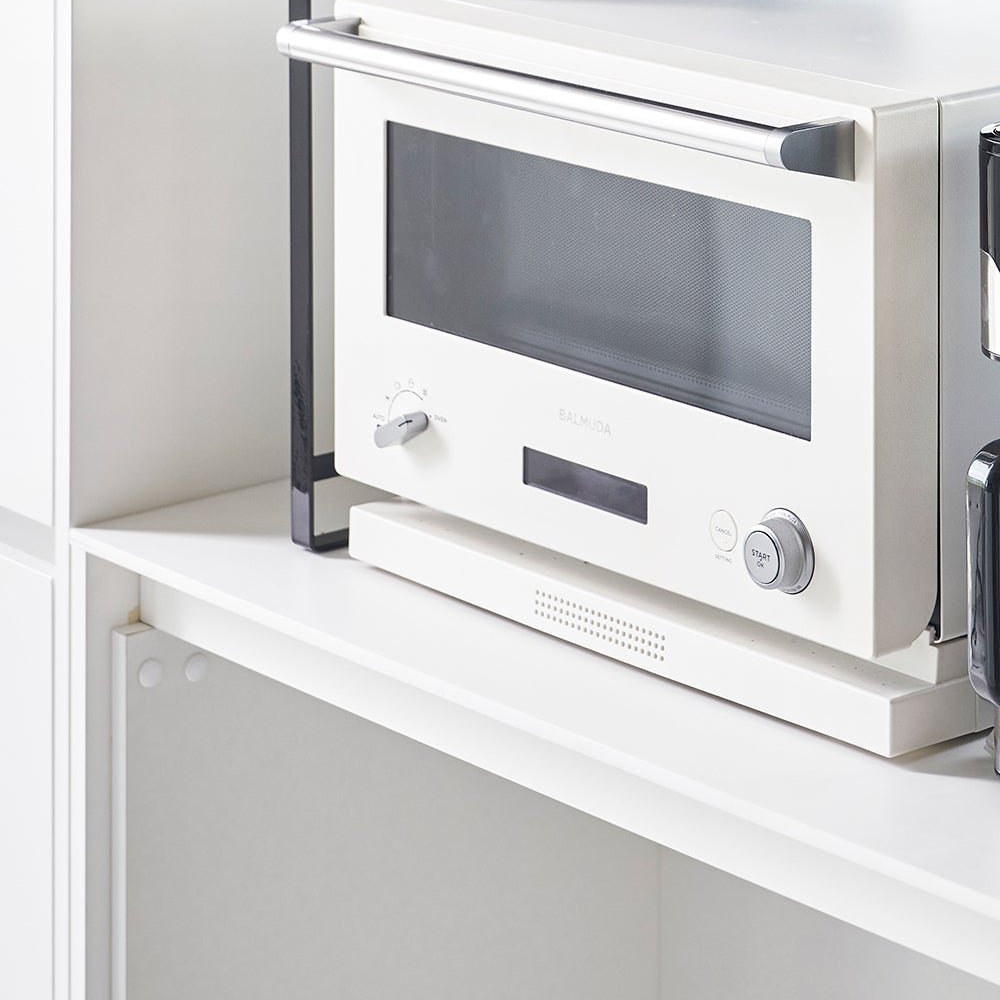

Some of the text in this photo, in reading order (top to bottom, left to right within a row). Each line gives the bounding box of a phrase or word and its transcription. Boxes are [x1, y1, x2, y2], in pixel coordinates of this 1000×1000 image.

[559, 408, 612, 437] BALMUDA
[714, 525, 733, 537] CANCEL
[751, 548, 771, 562] START
[756, 561, 765, 569] OK
